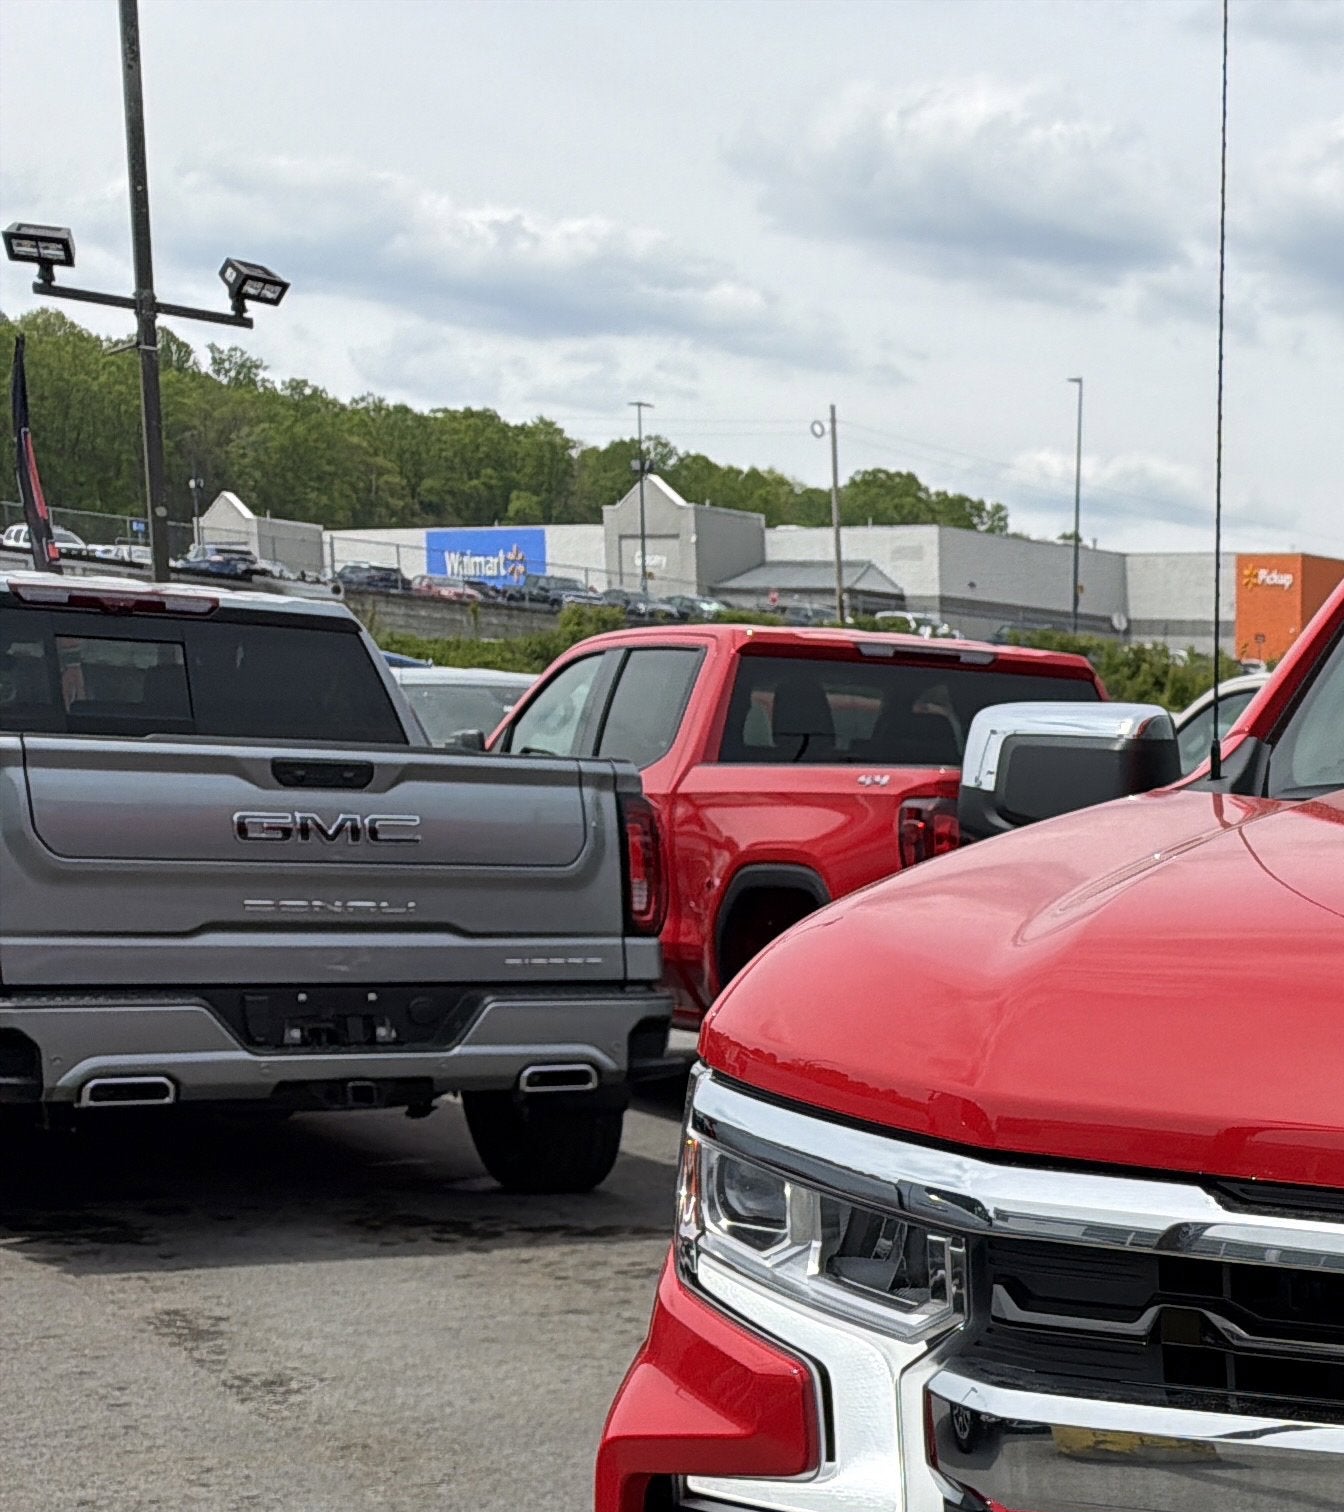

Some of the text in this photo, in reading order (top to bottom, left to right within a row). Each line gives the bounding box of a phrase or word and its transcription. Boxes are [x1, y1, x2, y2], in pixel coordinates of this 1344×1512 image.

[444, 549, 506, 577] Walmart
[233, 811, 422, 845] GMC
[243, 899, 416, 914] DENALI
